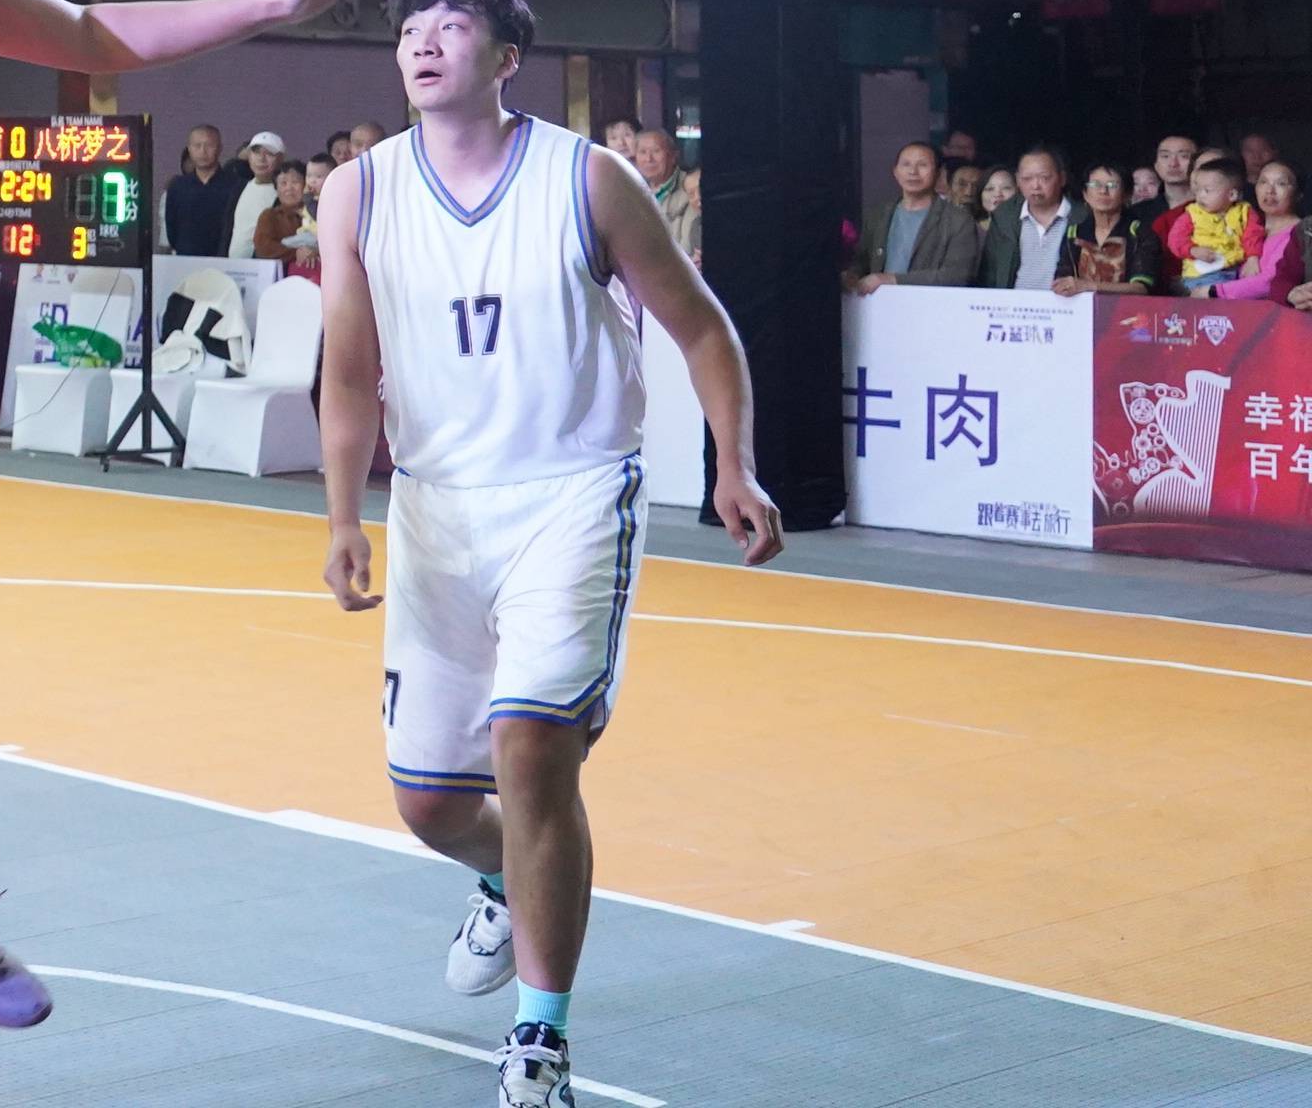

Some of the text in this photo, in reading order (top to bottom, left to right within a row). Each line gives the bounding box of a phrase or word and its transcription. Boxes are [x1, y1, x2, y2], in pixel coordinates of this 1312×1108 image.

[33, 126, 132, 163] 八桥梦之
[65, 115, 83, 127] TEAM
[0, 169, 53, 203] 2:24
[102, 170, 127, 224] 7
[126, 177, 140, 223] 比分
[9, 223, 35, 257] 12
[72, 225, 88, 261] 3
[449, 293, 503, 357] 17
[843, 366, 999, 467] 牛肉
[382, 667, 402, 729] 7
